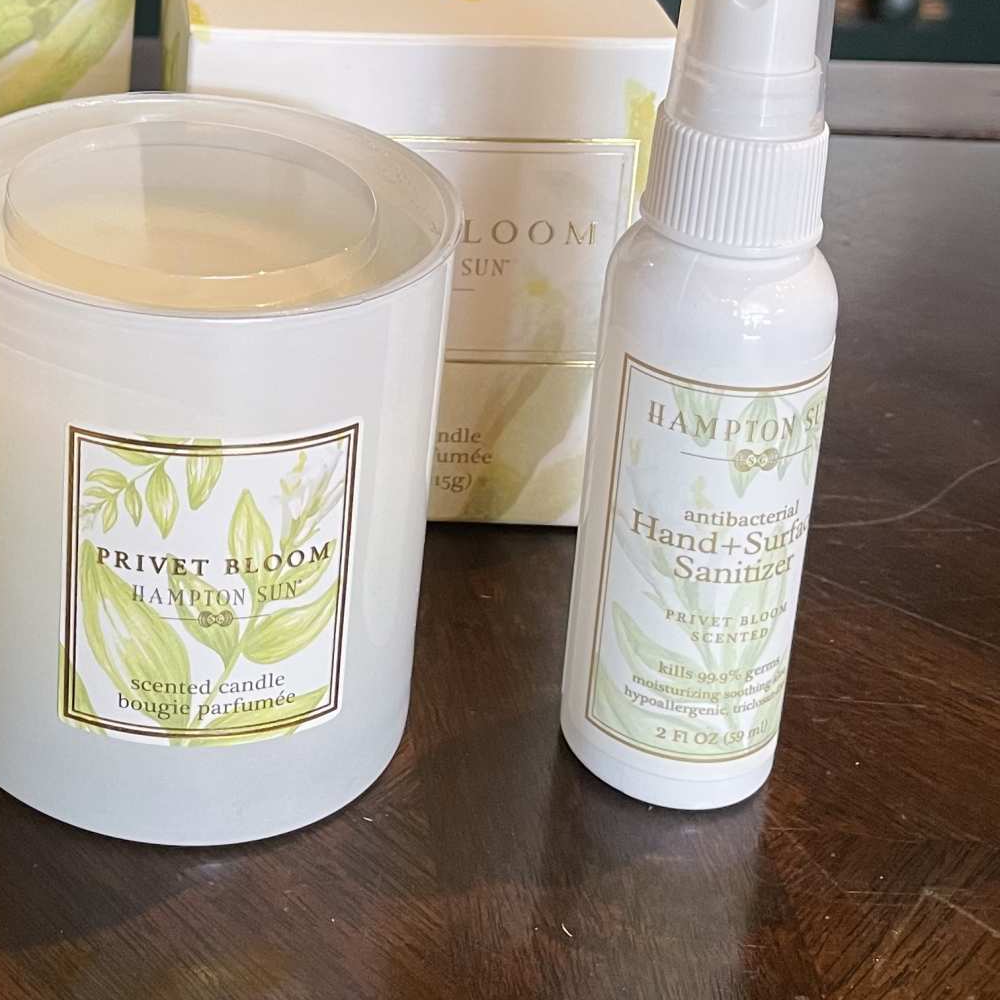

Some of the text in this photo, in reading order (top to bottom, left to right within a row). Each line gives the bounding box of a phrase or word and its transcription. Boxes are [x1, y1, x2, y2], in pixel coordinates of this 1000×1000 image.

[462, 219, 597, 245] LOOM
[647, 400, 797, 443] HAMPTON
[437, 427, 481, 444] ndle
[436, 447, 493, 465] umée
[435, 473, 473, 493] 15g)
[684, 499, 800, 527] antibacterial
[96, 542, 331, 576] PRIVET BLOOM
[673, 553, 795, 584] Sanitizer
[131, 583, 247, 606] HAMPTON
[664, 608, 733, 628] PRIVET
[690, 627, 769, 644] SCENTED
[130, 673, 286, 695] scented candle
[658, 660, 694, 680] kills
[697, 668, 743, 685] 99.9%
[631, 674, 722, 703] moisturizing
[118, 690, 296, 721] bougie parfumée
[655, 727, 667, 739] 2
